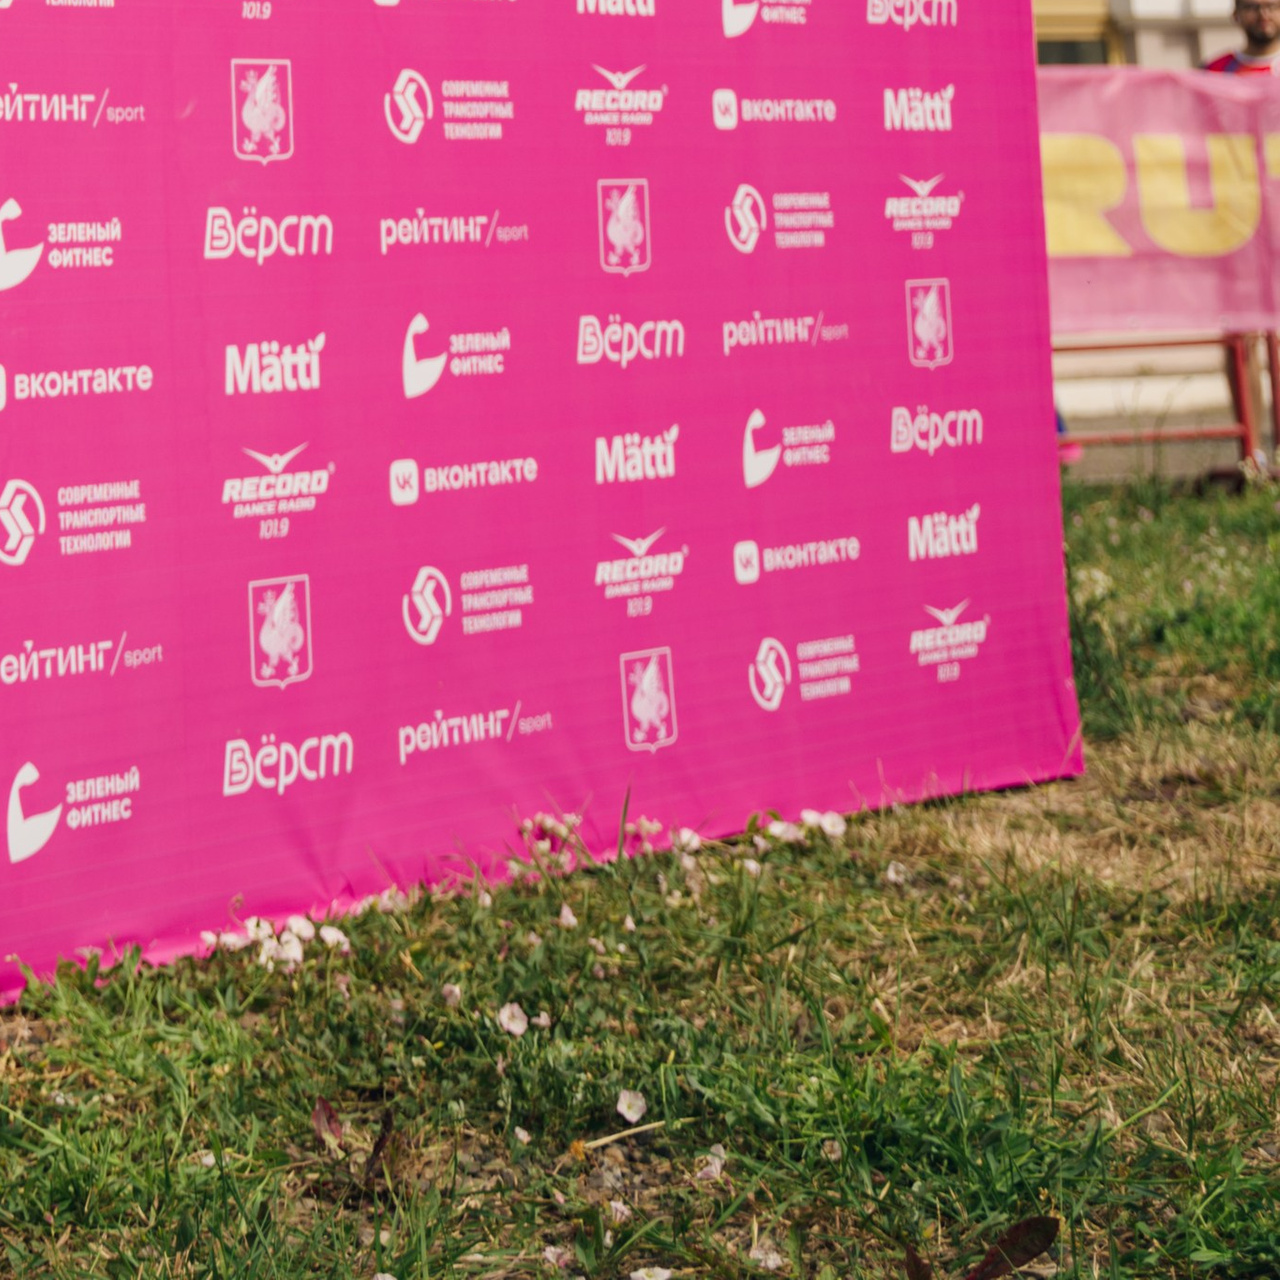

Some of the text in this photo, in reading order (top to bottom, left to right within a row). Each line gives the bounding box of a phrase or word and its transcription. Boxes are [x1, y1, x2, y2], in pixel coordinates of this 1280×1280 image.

[884, 84, 955, 132] Mätti
[1040, 132, 1280, 257] RU
[48, 217, 122, 243] ЗЕЛЕНЫЙ
[48, 246, 113, 268] ФИТНЕС
[449, 327, 511, 354] ЗЕЛЕНЫЙ
[225, 332, 326, 395] Mätti
[450, 353, 504, 376] ФИТНЕС
[595, 424, 679, 485] Mätti
[57, 480, 140, 506] СОВРЕМЕННЫЕ
[221, 467, 329, 504] RECORD
[59, 503, 146, 530] ТРАНСПОРТНЫЕ
[233, 496, 316, 518] DANCE RADIO
[59, 529, 131, 555] ТЕХНОЛОГИИ
[908, 503, 980, 561] Mätti
[66, 767, 140, 803] ЗЕЛЕНЫЙ
[66, 797, 132, 830] ФИТНЕС
